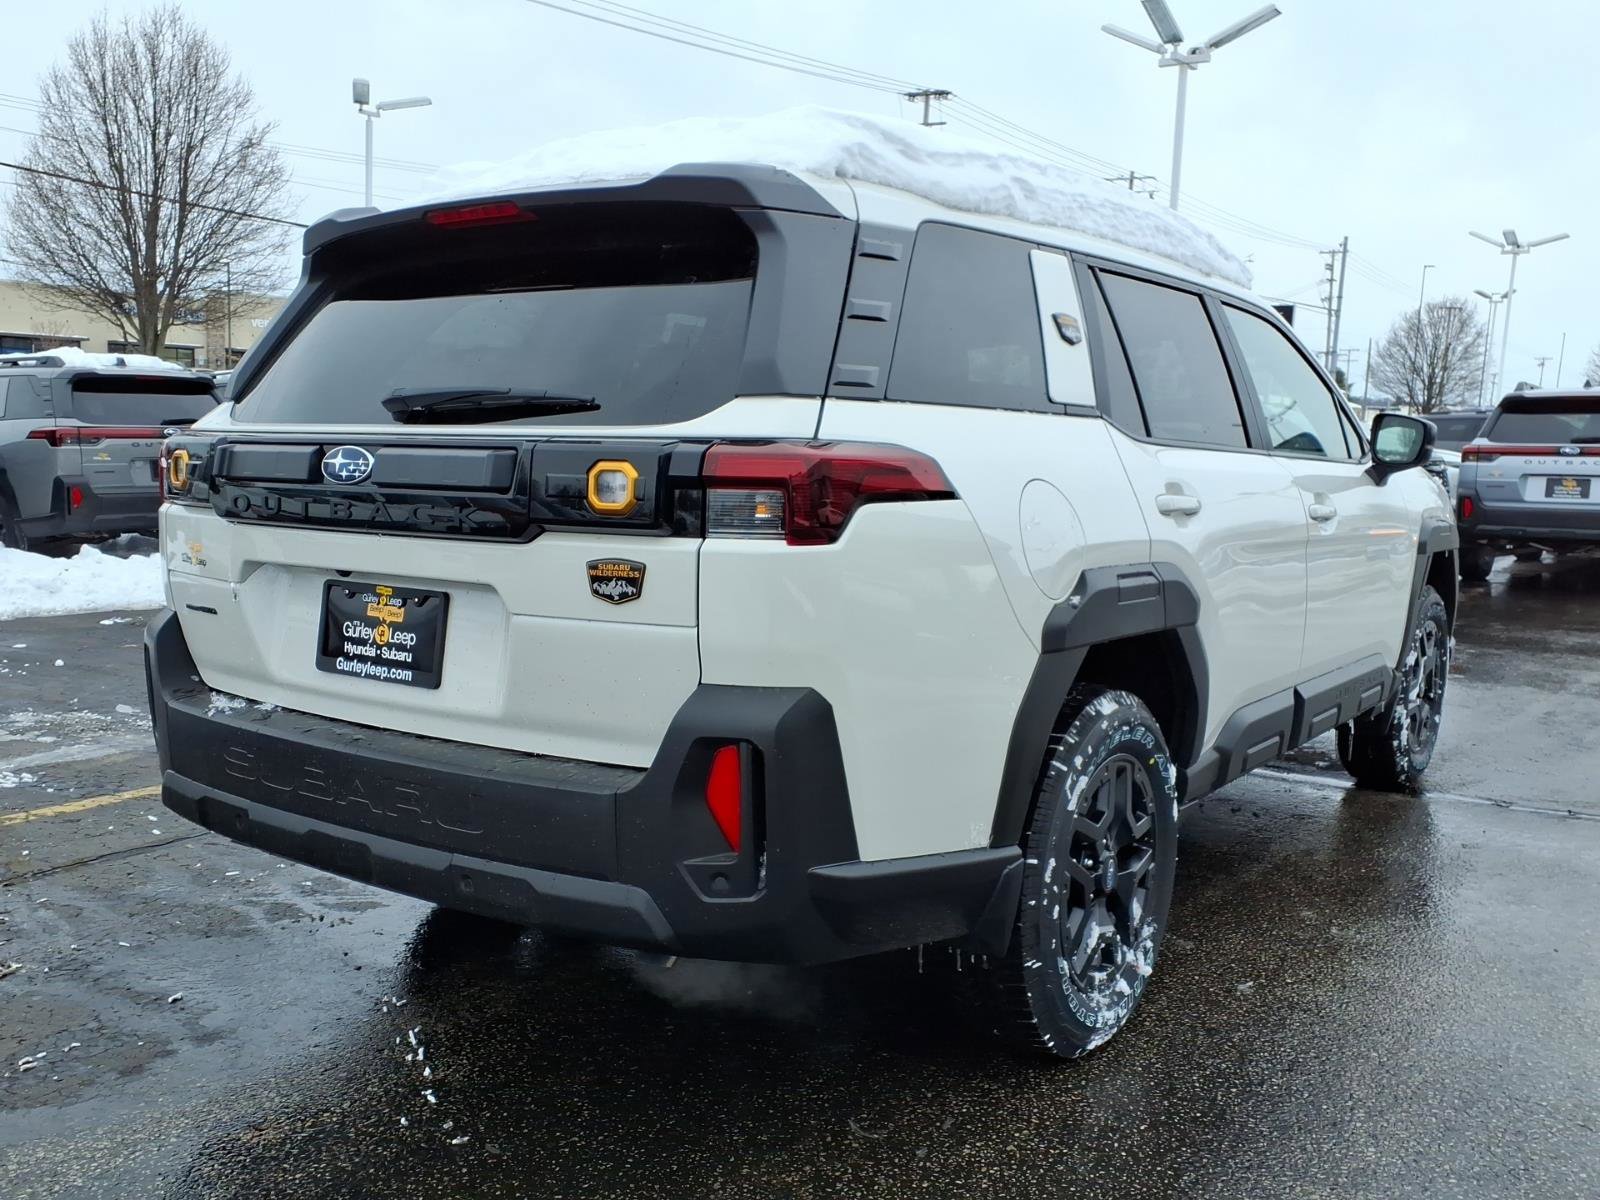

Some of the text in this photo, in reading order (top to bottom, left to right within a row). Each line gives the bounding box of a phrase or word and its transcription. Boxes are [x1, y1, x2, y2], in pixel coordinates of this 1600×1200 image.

[251, 318, 272, 328] ver
[232, 494, 480, 530] OUTBACK
[589, 569, 640, 578] WILDERNESS
[598, 563, 631, 571] SUBARU
[343, 621, 376, 643] Gurley
[388, 627, 416, 648] Leep
[344, 641, 412, 662] Hyundai Subaru
[336, 657, 412, 681] Gurleyleep.com
[223, 747, 485, 834] SUBARU
